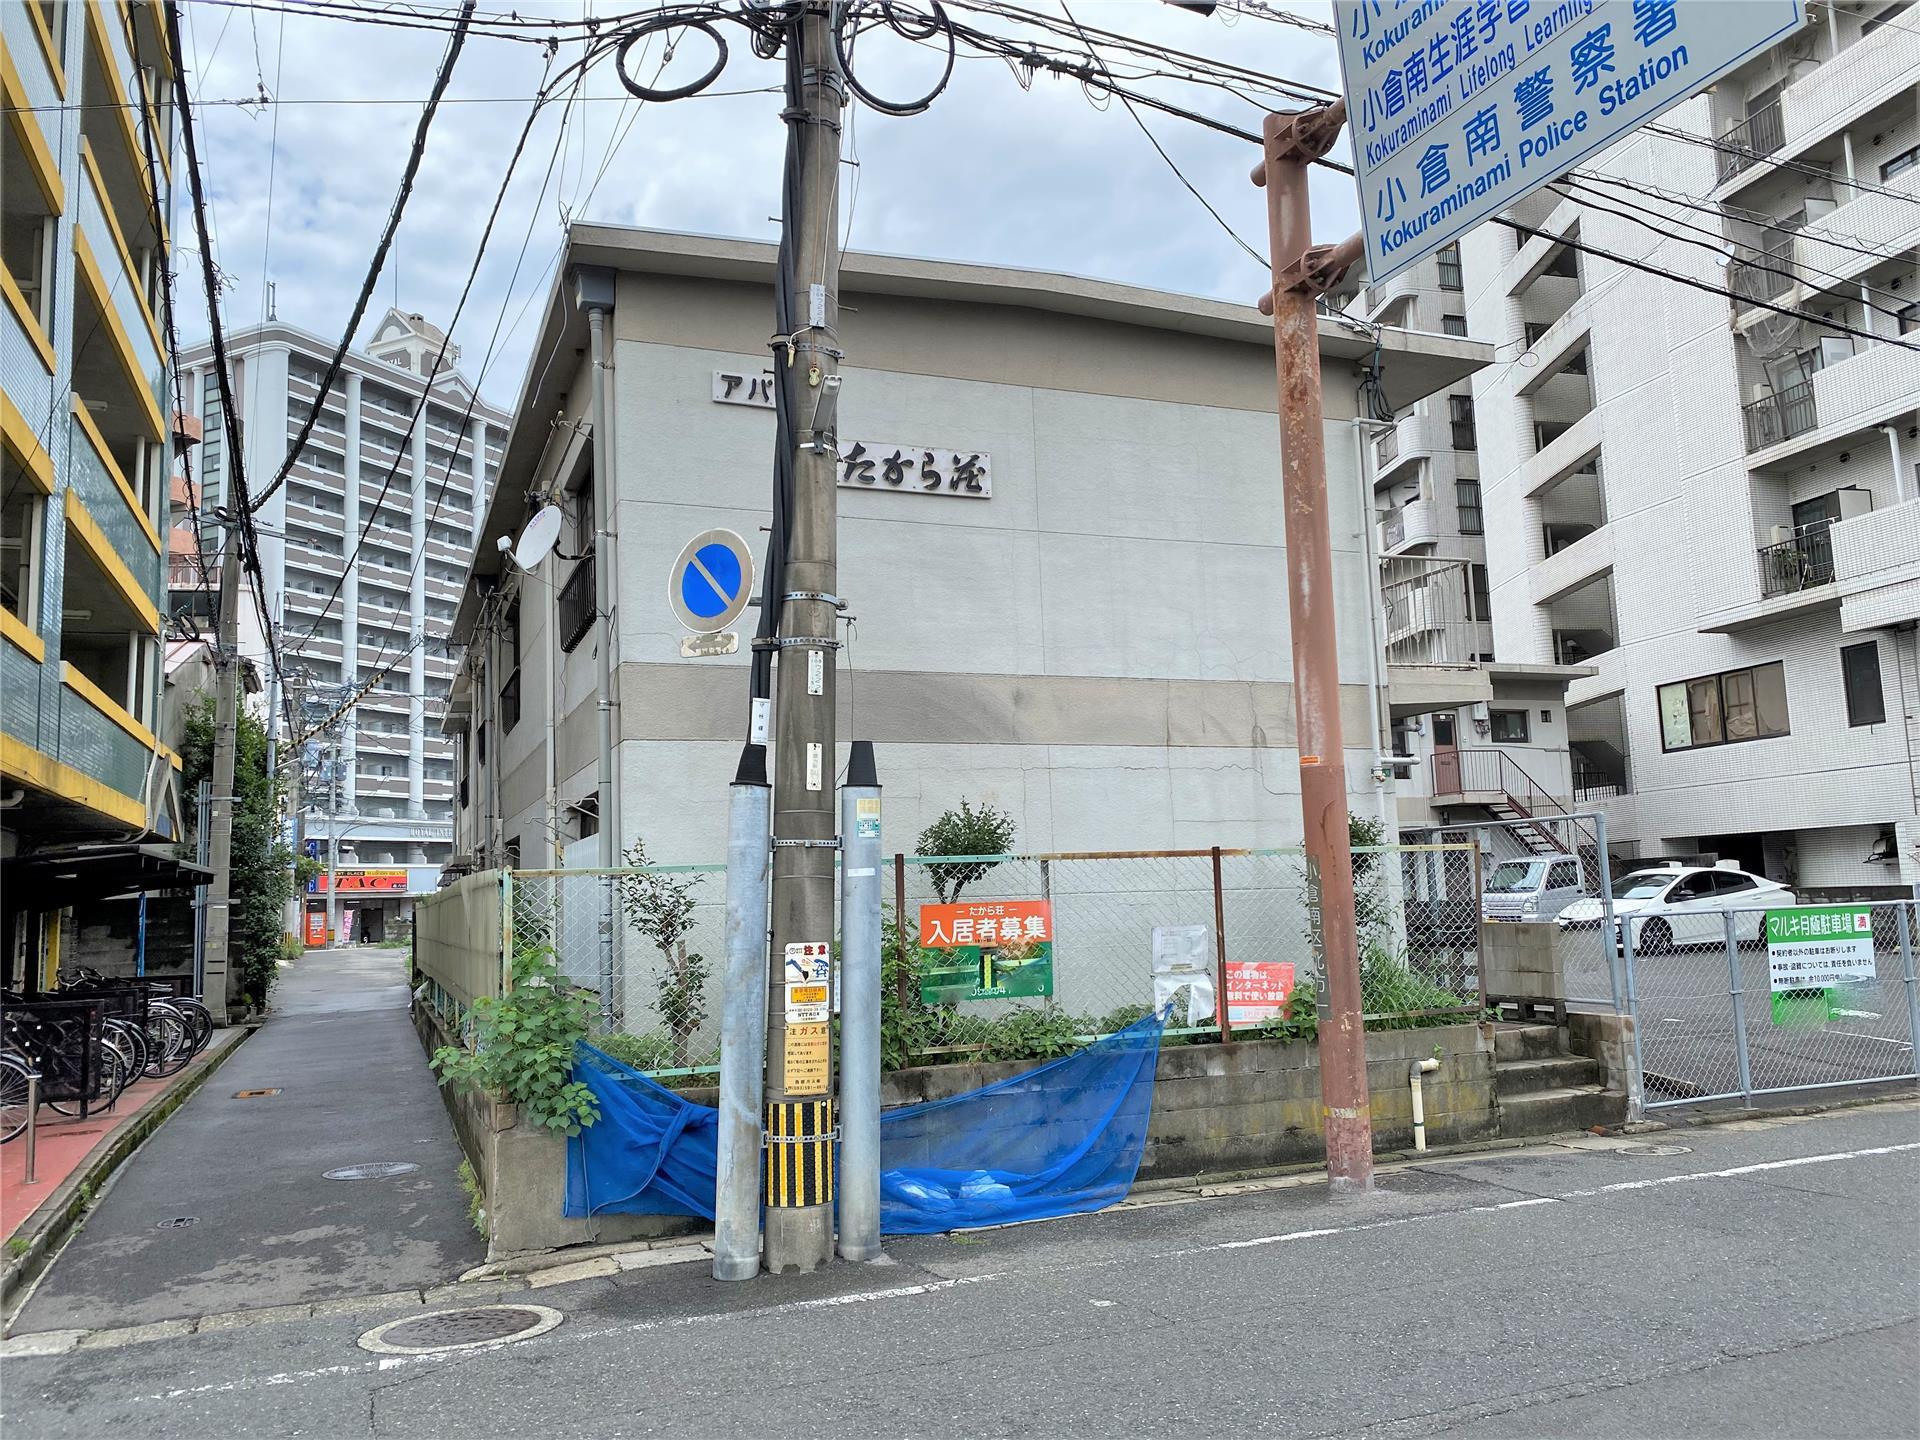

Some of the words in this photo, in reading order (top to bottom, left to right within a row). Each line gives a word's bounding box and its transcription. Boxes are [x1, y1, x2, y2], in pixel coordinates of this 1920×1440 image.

[1366, 87, 1452, 168] Kokuraminami
[1459, 42, 1516, 100] Lifelong
[1377, 0, 1677, 223] 小倉南警察署
[1380, 152, 1512, 257] Kokuraminami
[1519, 109, 1588, 169] Police
[1599, 44, 1689, 116] Station
[969, 905, 1005, 916] たから荘
[926, 915, 1047, 944] 入居者募集
[1769, 913, 1852, 937] マルキ月極駐車場
[804, 945, 826, 956] 注意
[1226, 980, 1284, 991] インターネット
